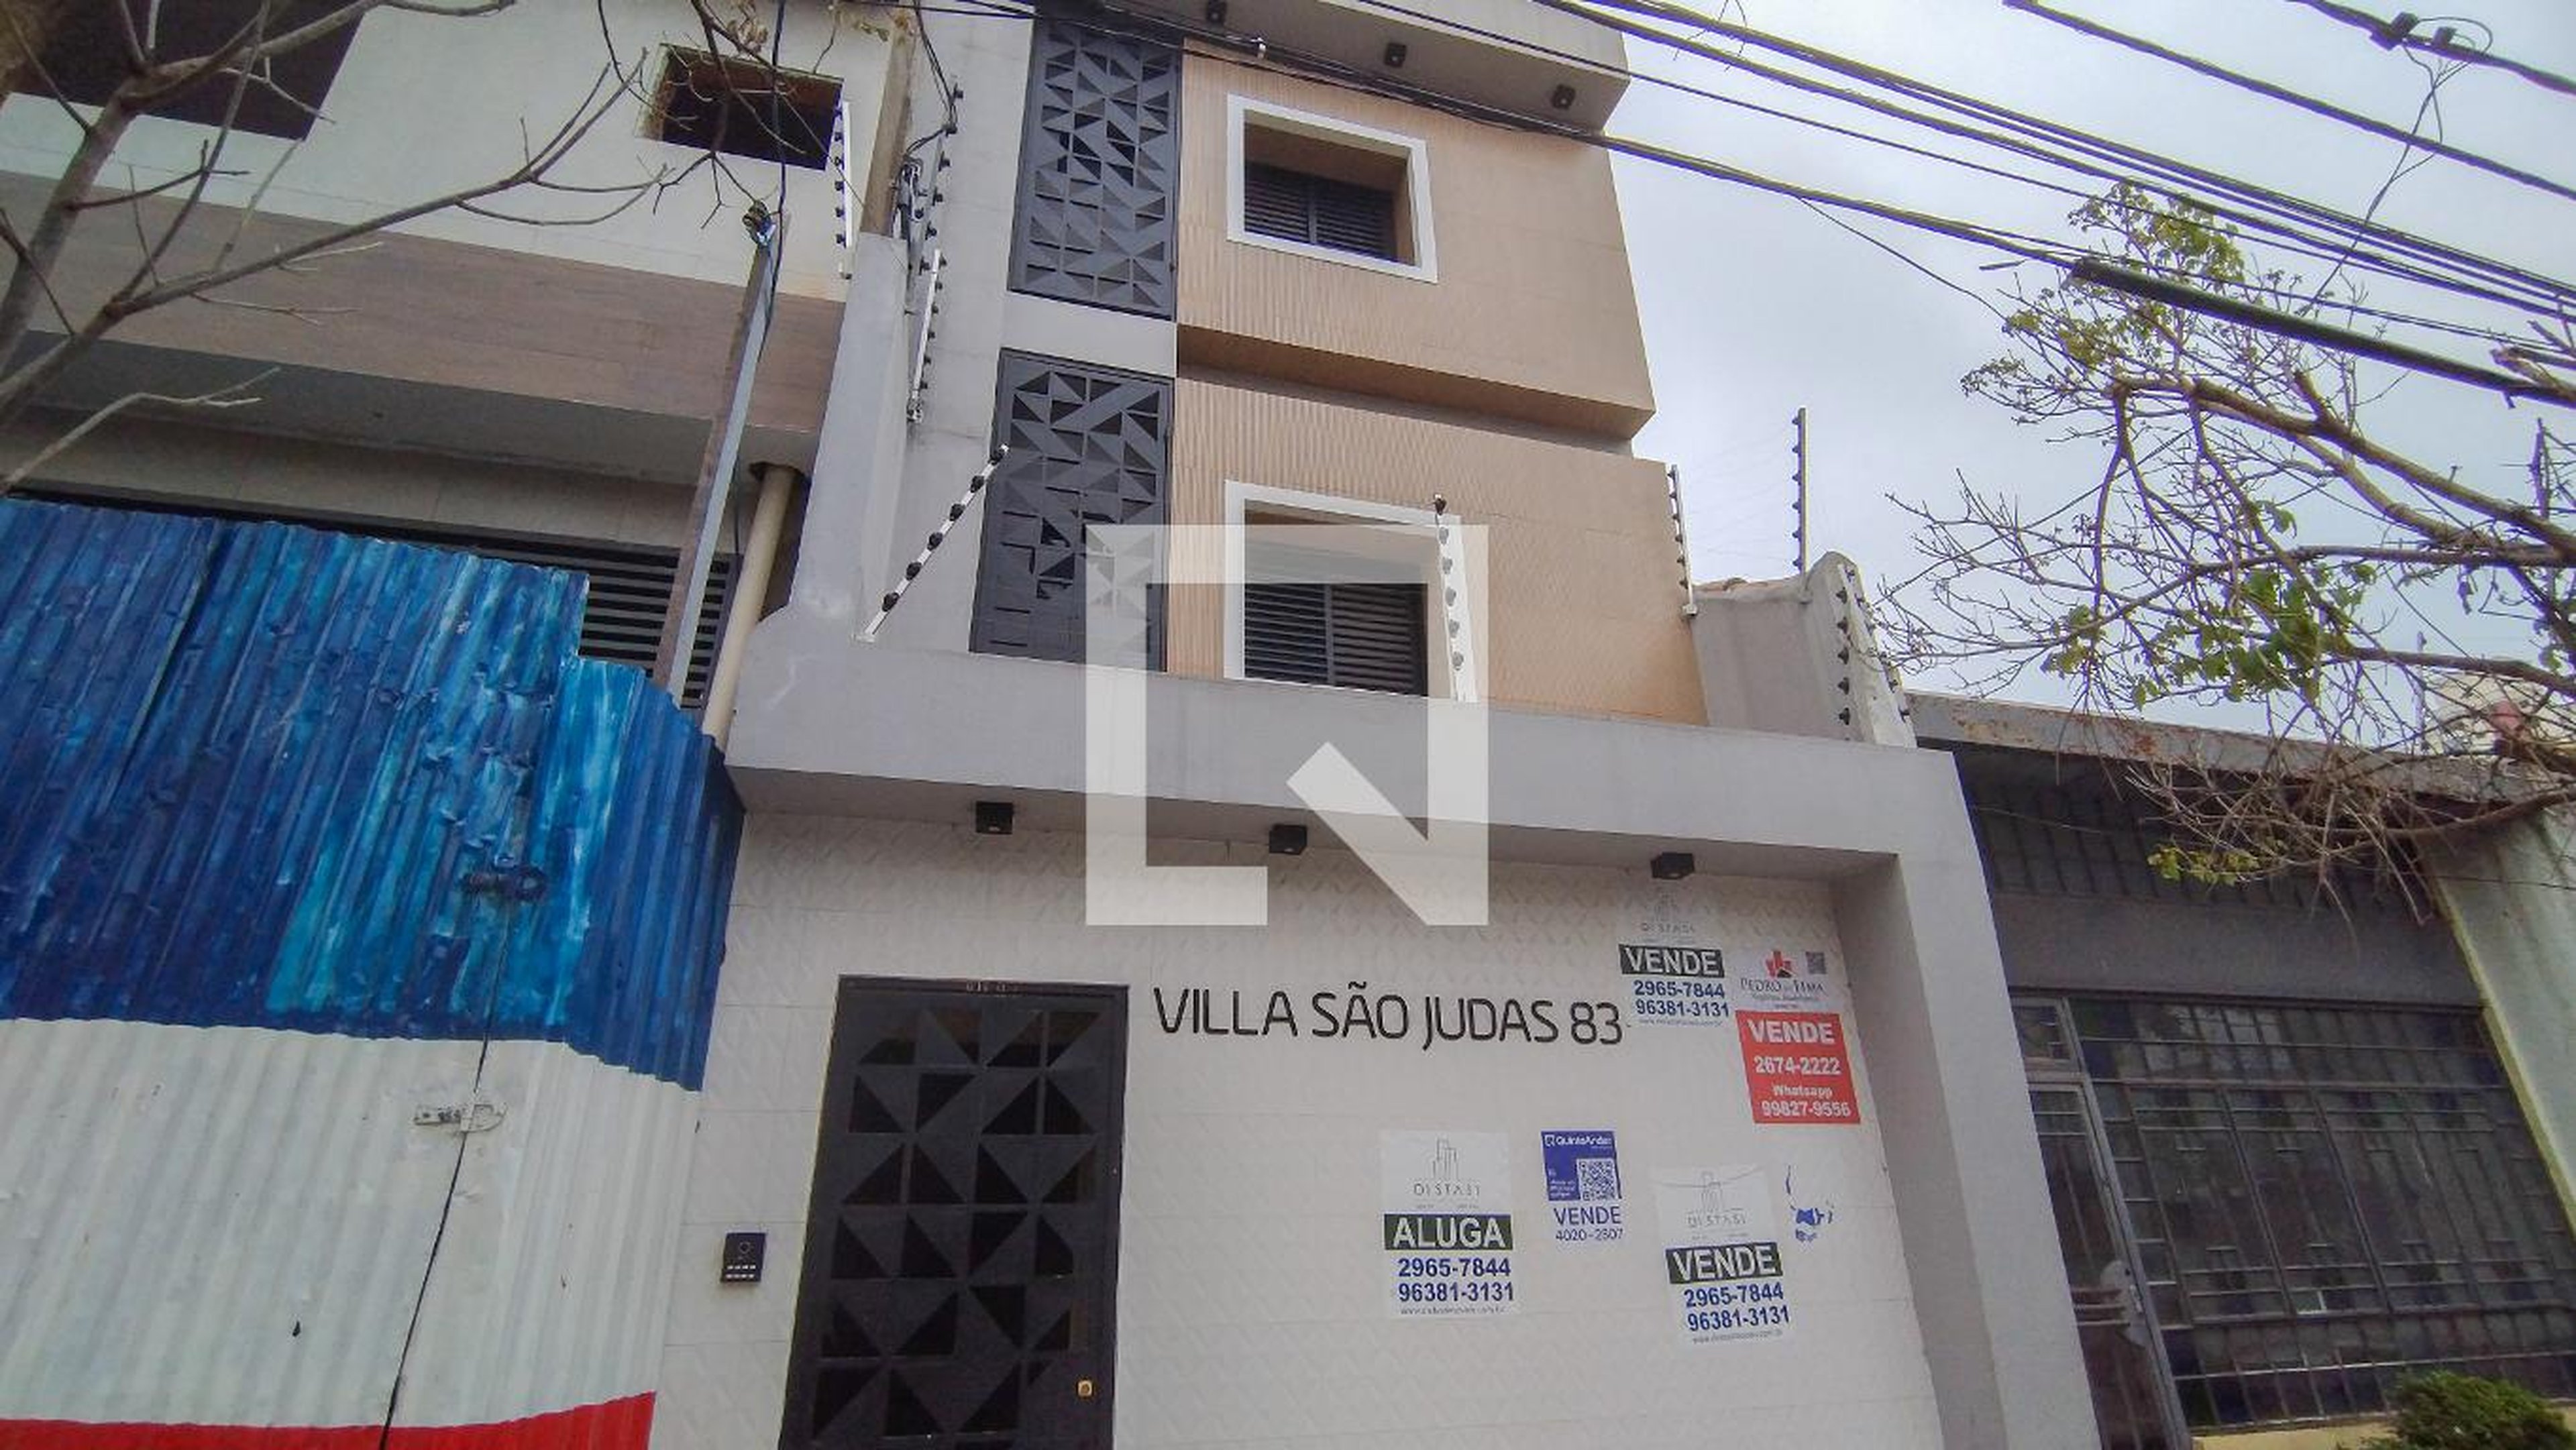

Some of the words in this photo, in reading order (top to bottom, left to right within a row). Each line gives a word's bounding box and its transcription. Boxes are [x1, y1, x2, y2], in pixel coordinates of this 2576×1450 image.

[1625, 947, 1719, 975] VENDE
[1633, 980, 1725, 998] 2965-7844
[1153, 987, 1298, 1036] VILLA
[1311, 981, 1409, 1040] SÃO
[1421, 995, 1559, 1050] JUDAS
[1570, 1001, 1623, 1045] 83
[1635, 999, 1729, 1017] 96381-3131
[1747, 1019, 1835, 1044] VENDE
[1754, 1055, 1841, 1075] 2674-2222
[1772, 1083, 1833, 1099] Whatsapp
[1761, 1100, 1851, 1118] 99827-9556
[1553, 1207, 1622, 1225] VENDE
[1393, 1217, 1506, 1248] ALUGA
[1397, 1257, 1511, 1278] 2965-7844
[1672, 1245, 1777, 1281] VENDE
[1398, 1282, 1514, 1302] 96381-3131
[1684, 1282, 1784, 1308] 2965-7844
[1687, 1304, 1790, 1331] 96381-3131
